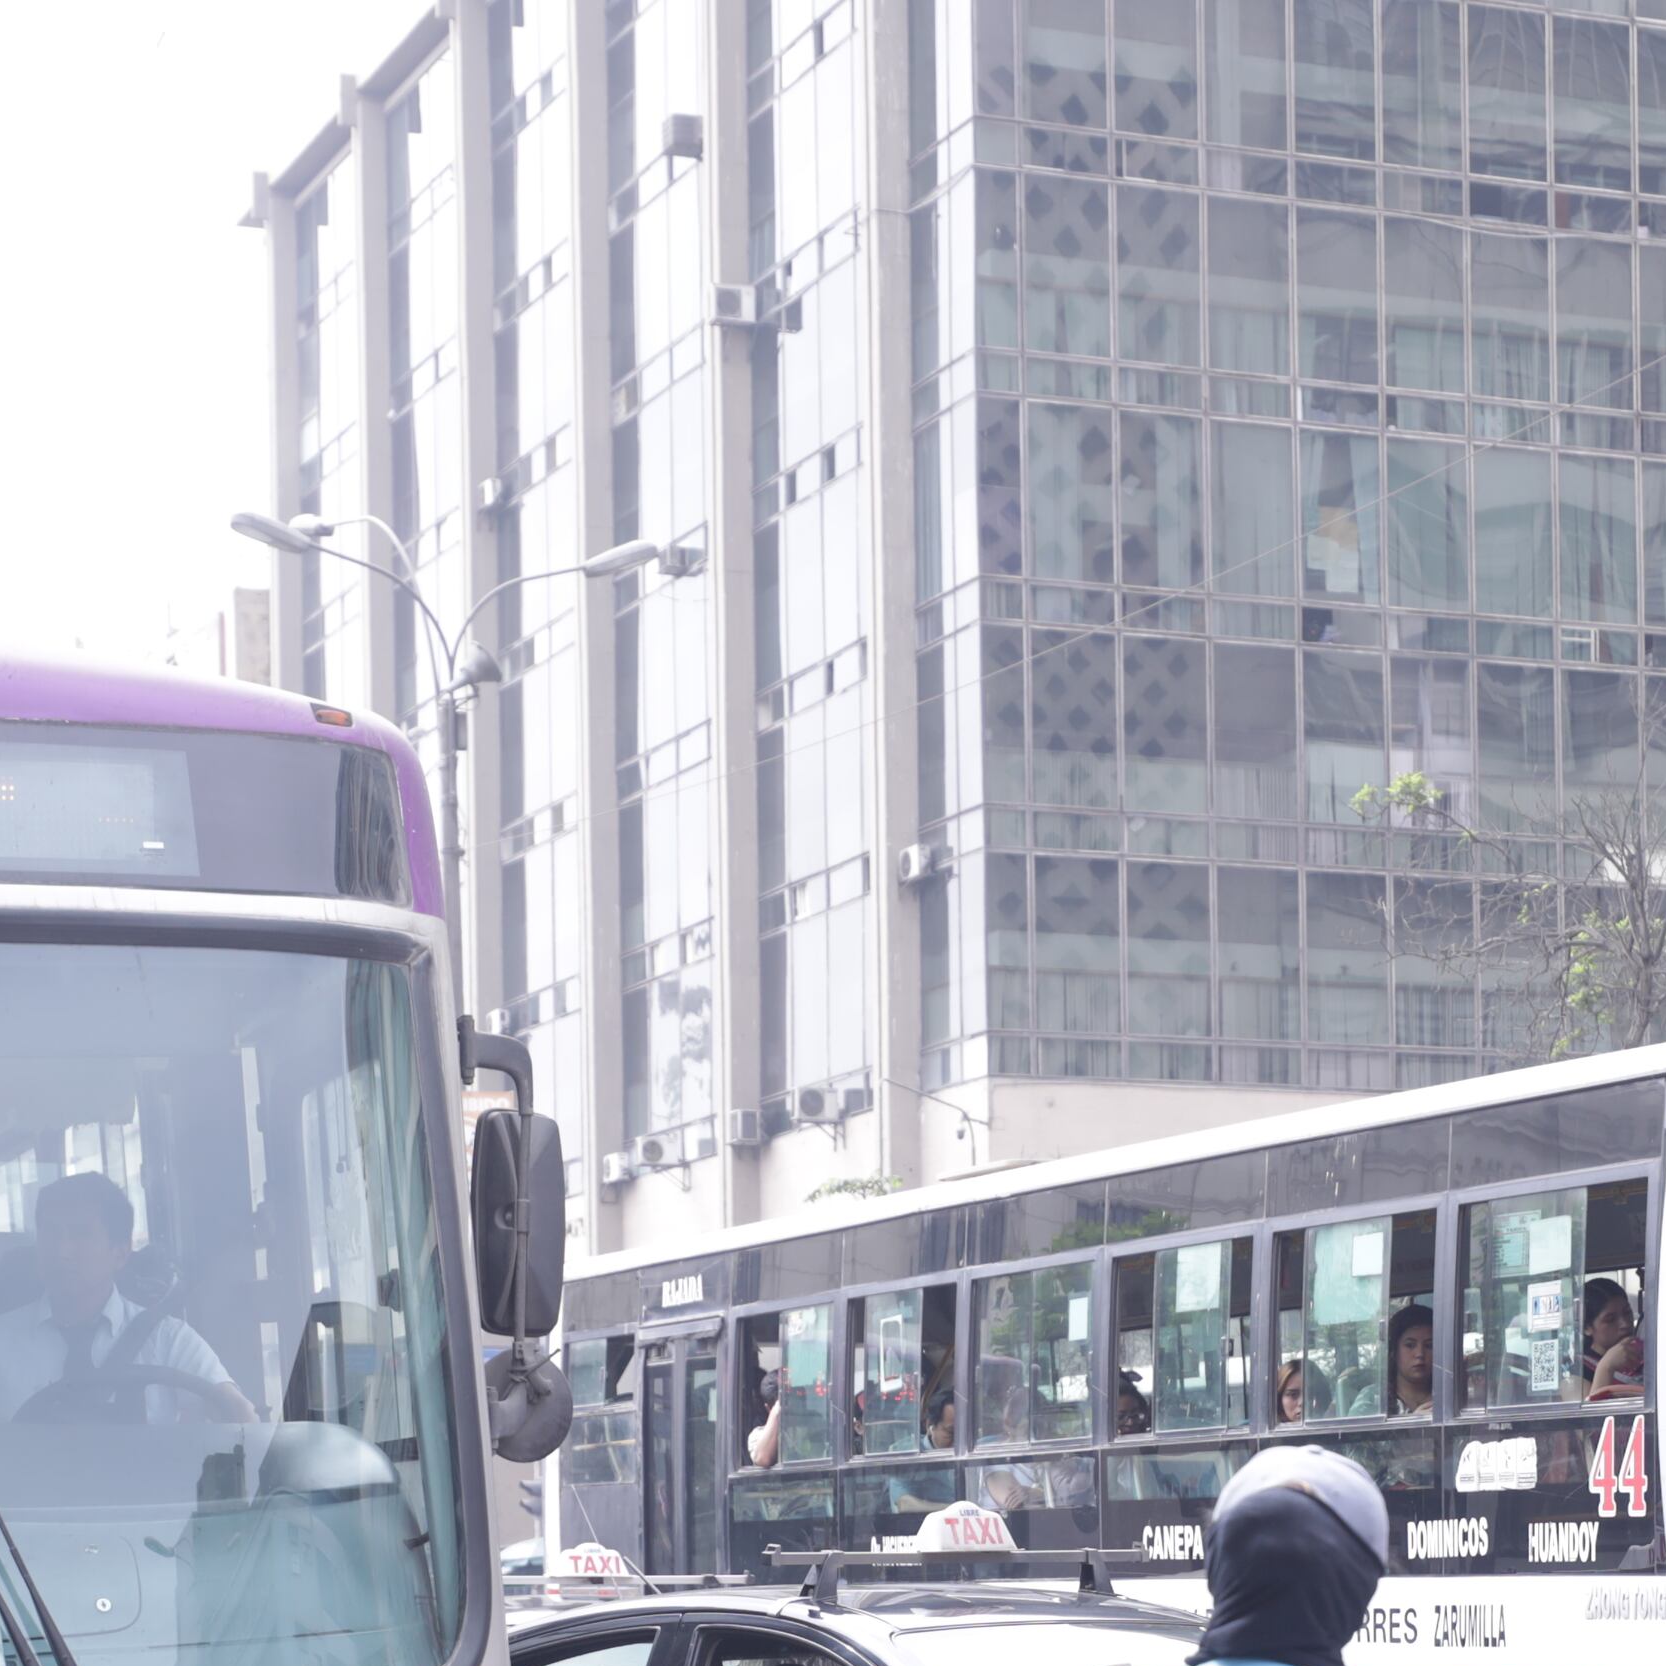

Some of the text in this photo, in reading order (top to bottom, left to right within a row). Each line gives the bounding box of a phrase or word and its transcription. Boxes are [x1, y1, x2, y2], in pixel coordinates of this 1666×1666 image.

[1589, 1415, 1648, 1517] 44
[944, 1517, 1006, 1545] TAXI
[1142, 1525, 1205, 1560] CANEPA
[1406, 1516, 1489, 1560] DOMINICOS
[1528, 1521, 1600, 1563] HUANDOY
[569, 1555, 621, 1574] TAXI
[1357, 1604, 1507, 1647] RRES ZARUMILLA
